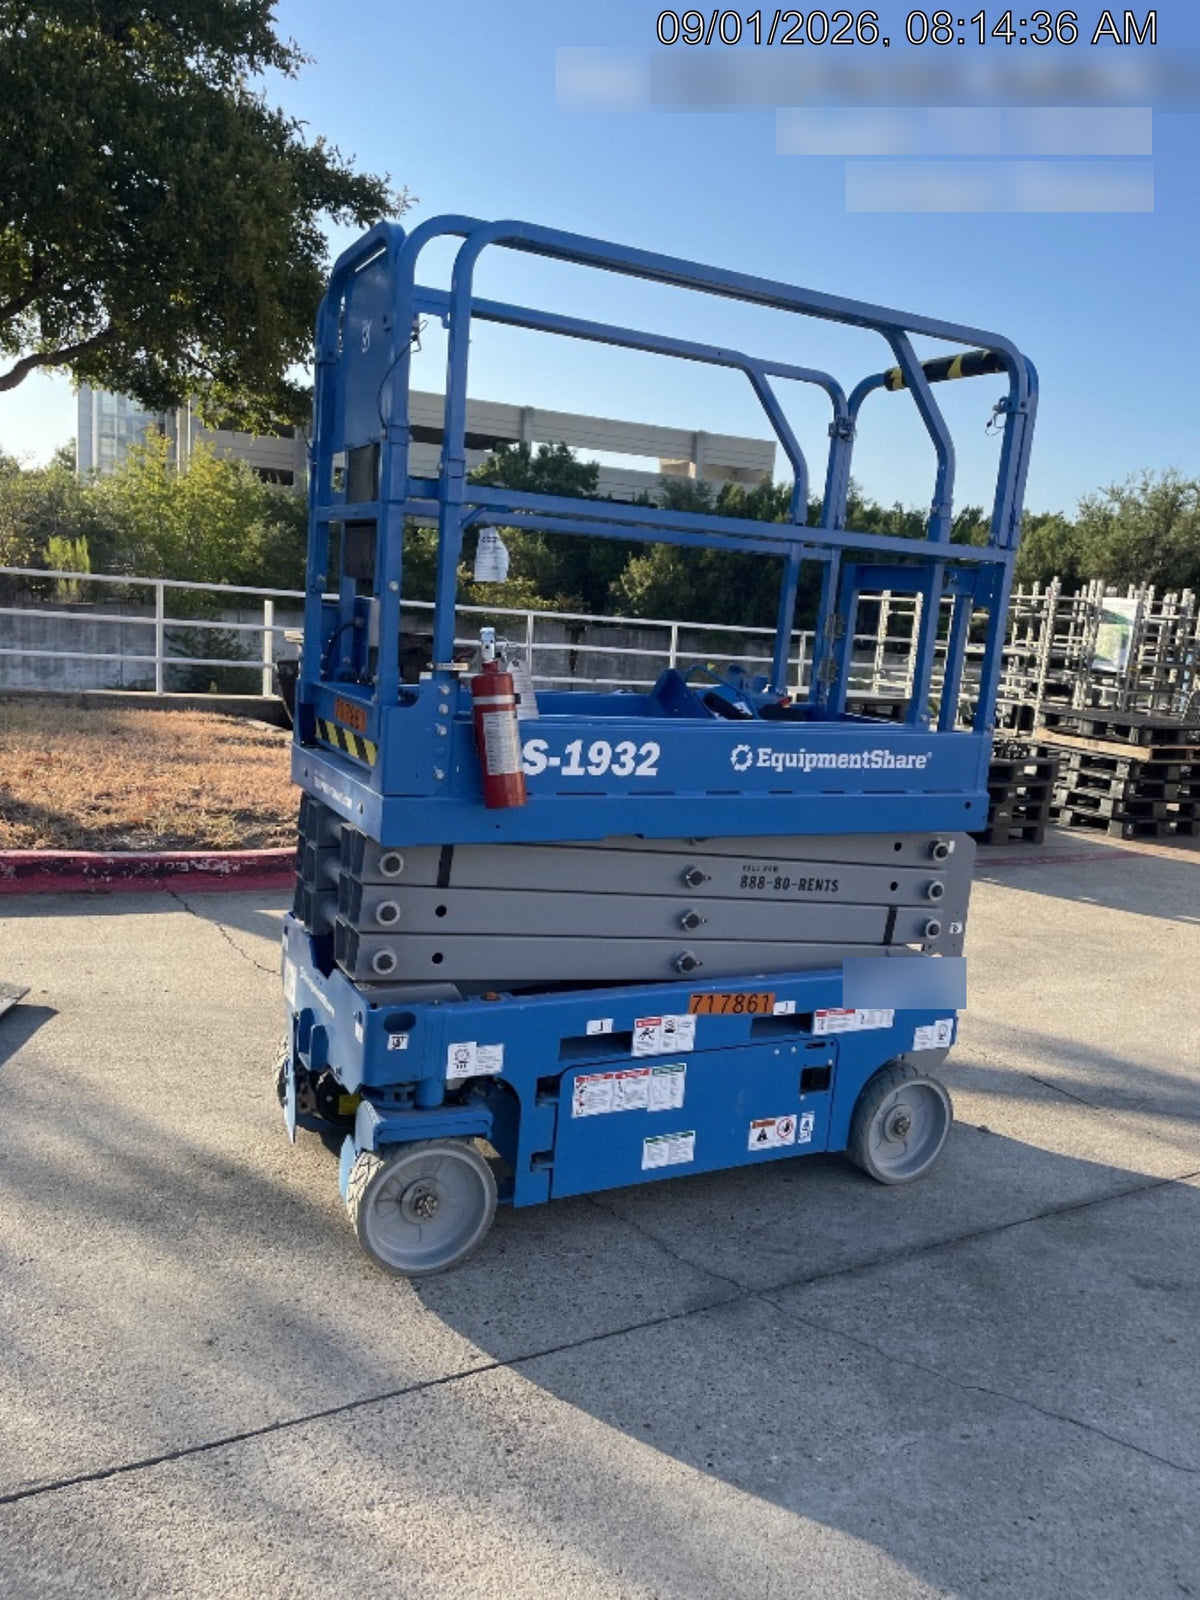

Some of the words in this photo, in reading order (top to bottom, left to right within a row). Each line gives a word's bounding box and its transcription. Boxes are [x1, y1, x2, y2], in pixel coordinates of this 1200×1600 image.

[522, 739, 661, 776] S-1932
[756, 748, 927, 773] EquipmentShare
[740, 874, 839, 893] 888-80-RENTS
[692, 993, 769, 1014] 717861
